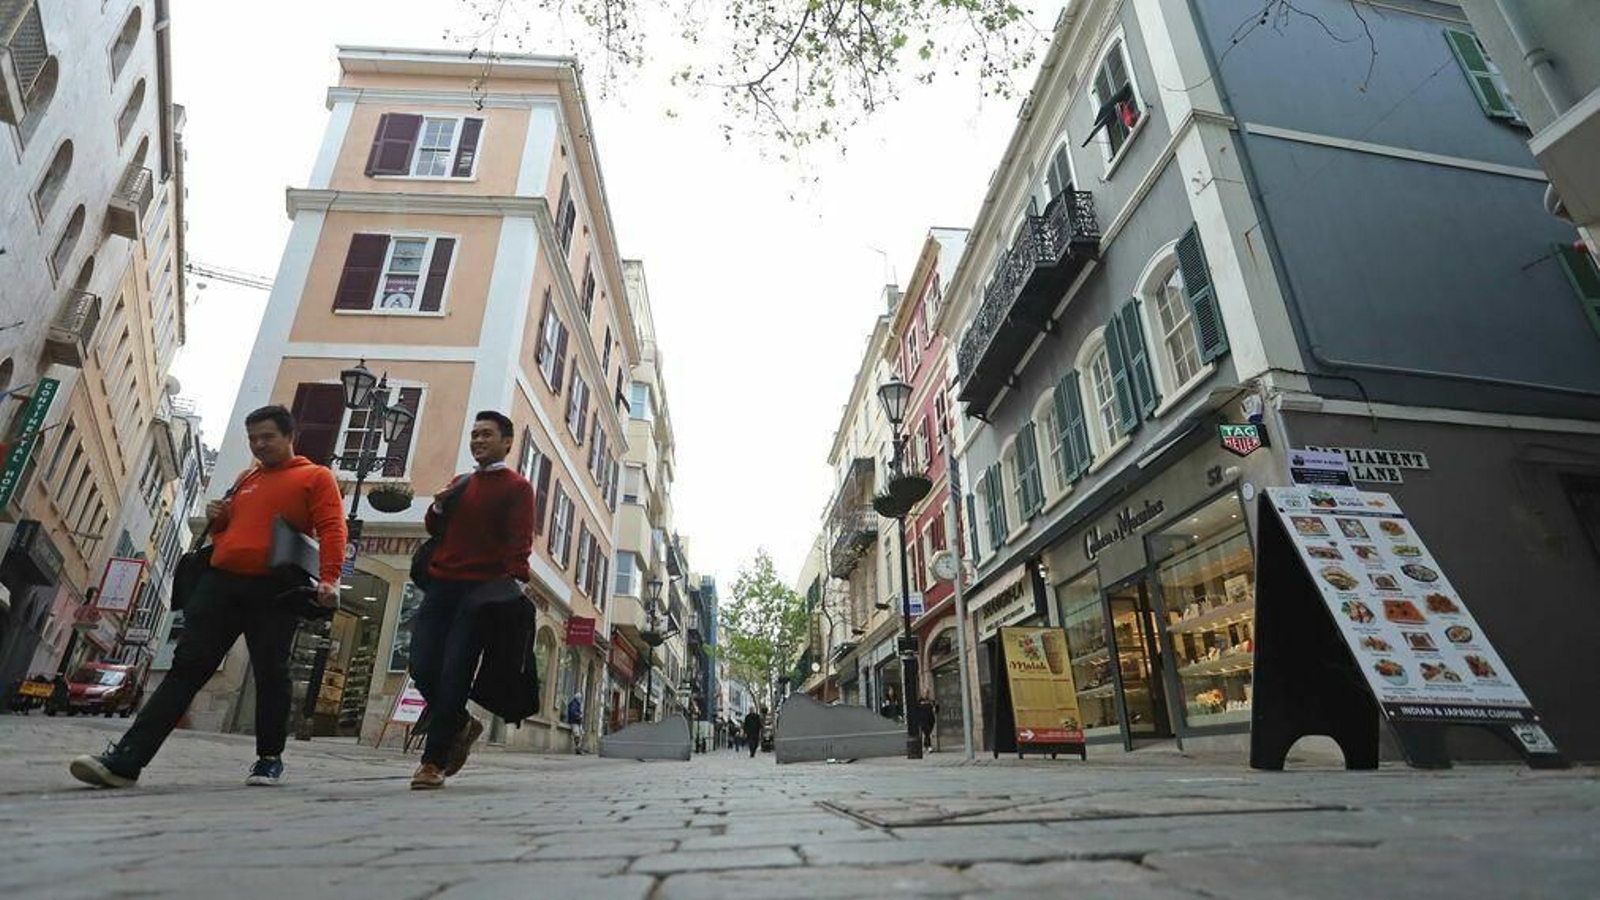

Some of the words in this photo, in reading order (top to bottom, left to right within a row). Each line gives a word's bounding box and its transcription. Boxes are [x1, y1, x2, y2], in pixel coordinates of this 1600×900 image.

[1223, 426, 1256, 437] TAG
[1225, 436, 1260, 452] HEUER
[1352, 465, 1400, 481] LANE
[1400, 706, 1434, 716] INDIAN
[1444, 708, 1487, 718] JAPANESE
